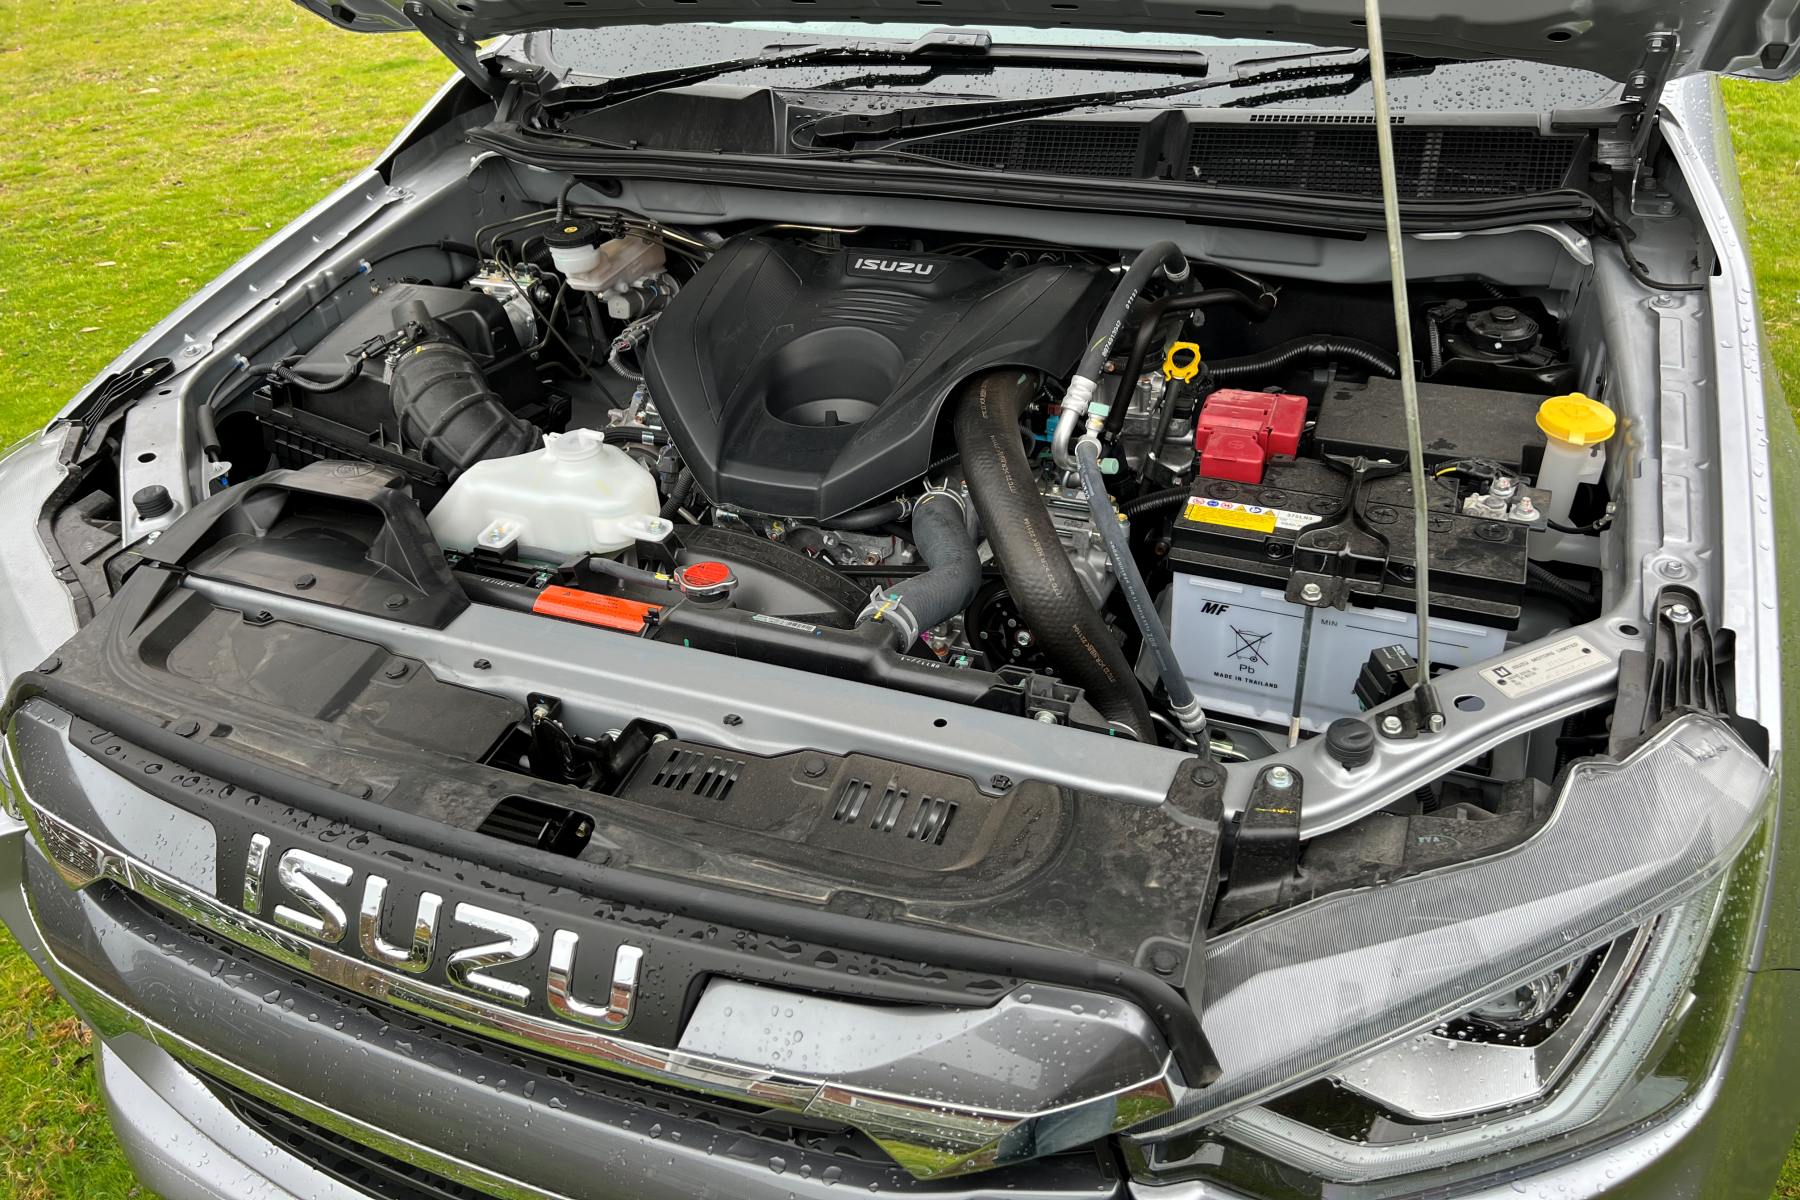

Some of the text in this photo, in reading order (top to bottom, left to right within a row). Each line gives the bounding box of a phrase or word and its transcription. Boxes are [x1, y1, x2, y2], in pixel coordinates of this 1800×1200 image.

[855, 258, 934, 275] ISUZU
[1200, 601, 1230, 616] MF
[1320, 618, 1338, 627] MIN
[1239, 663, 1255, 674] Pb
[1213, 671, 1232, 680] MADE
[1244, 677, 1278, 689] THAILAND
[242, 833, 643, 1031] ISUZU
